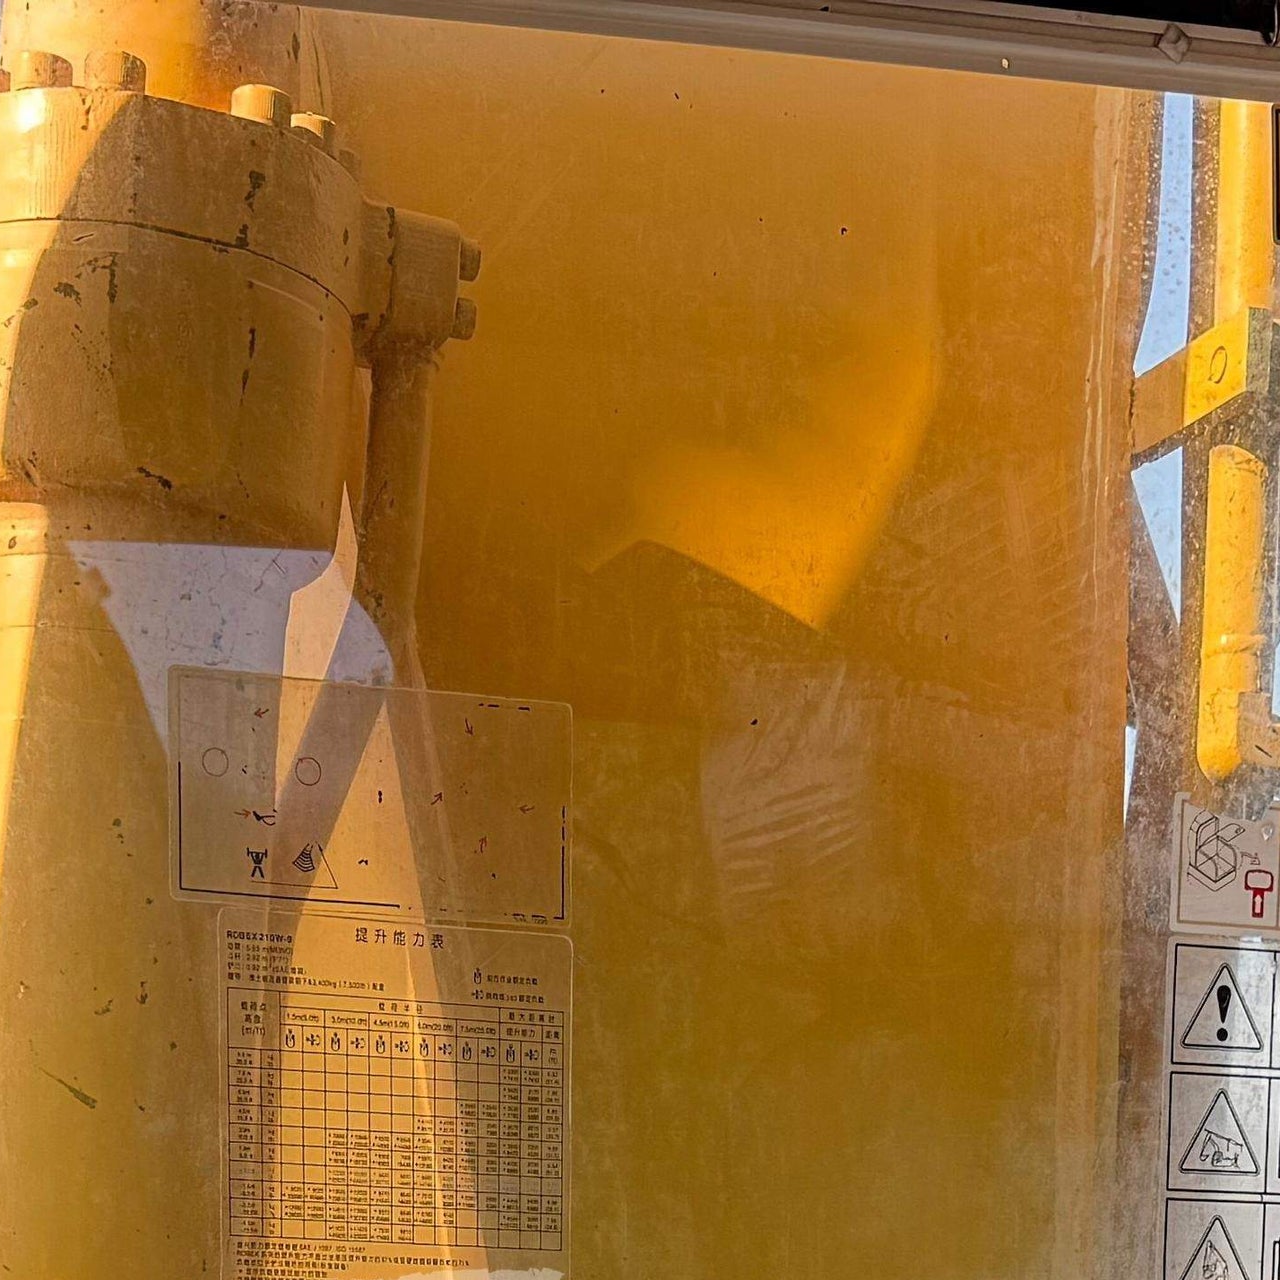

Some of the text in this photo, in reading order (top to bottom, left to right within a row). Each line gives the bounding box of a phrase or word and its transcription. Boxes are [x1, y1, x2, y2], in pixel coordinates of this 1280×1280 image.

[355, 926, 445, 949] 提升能力表
